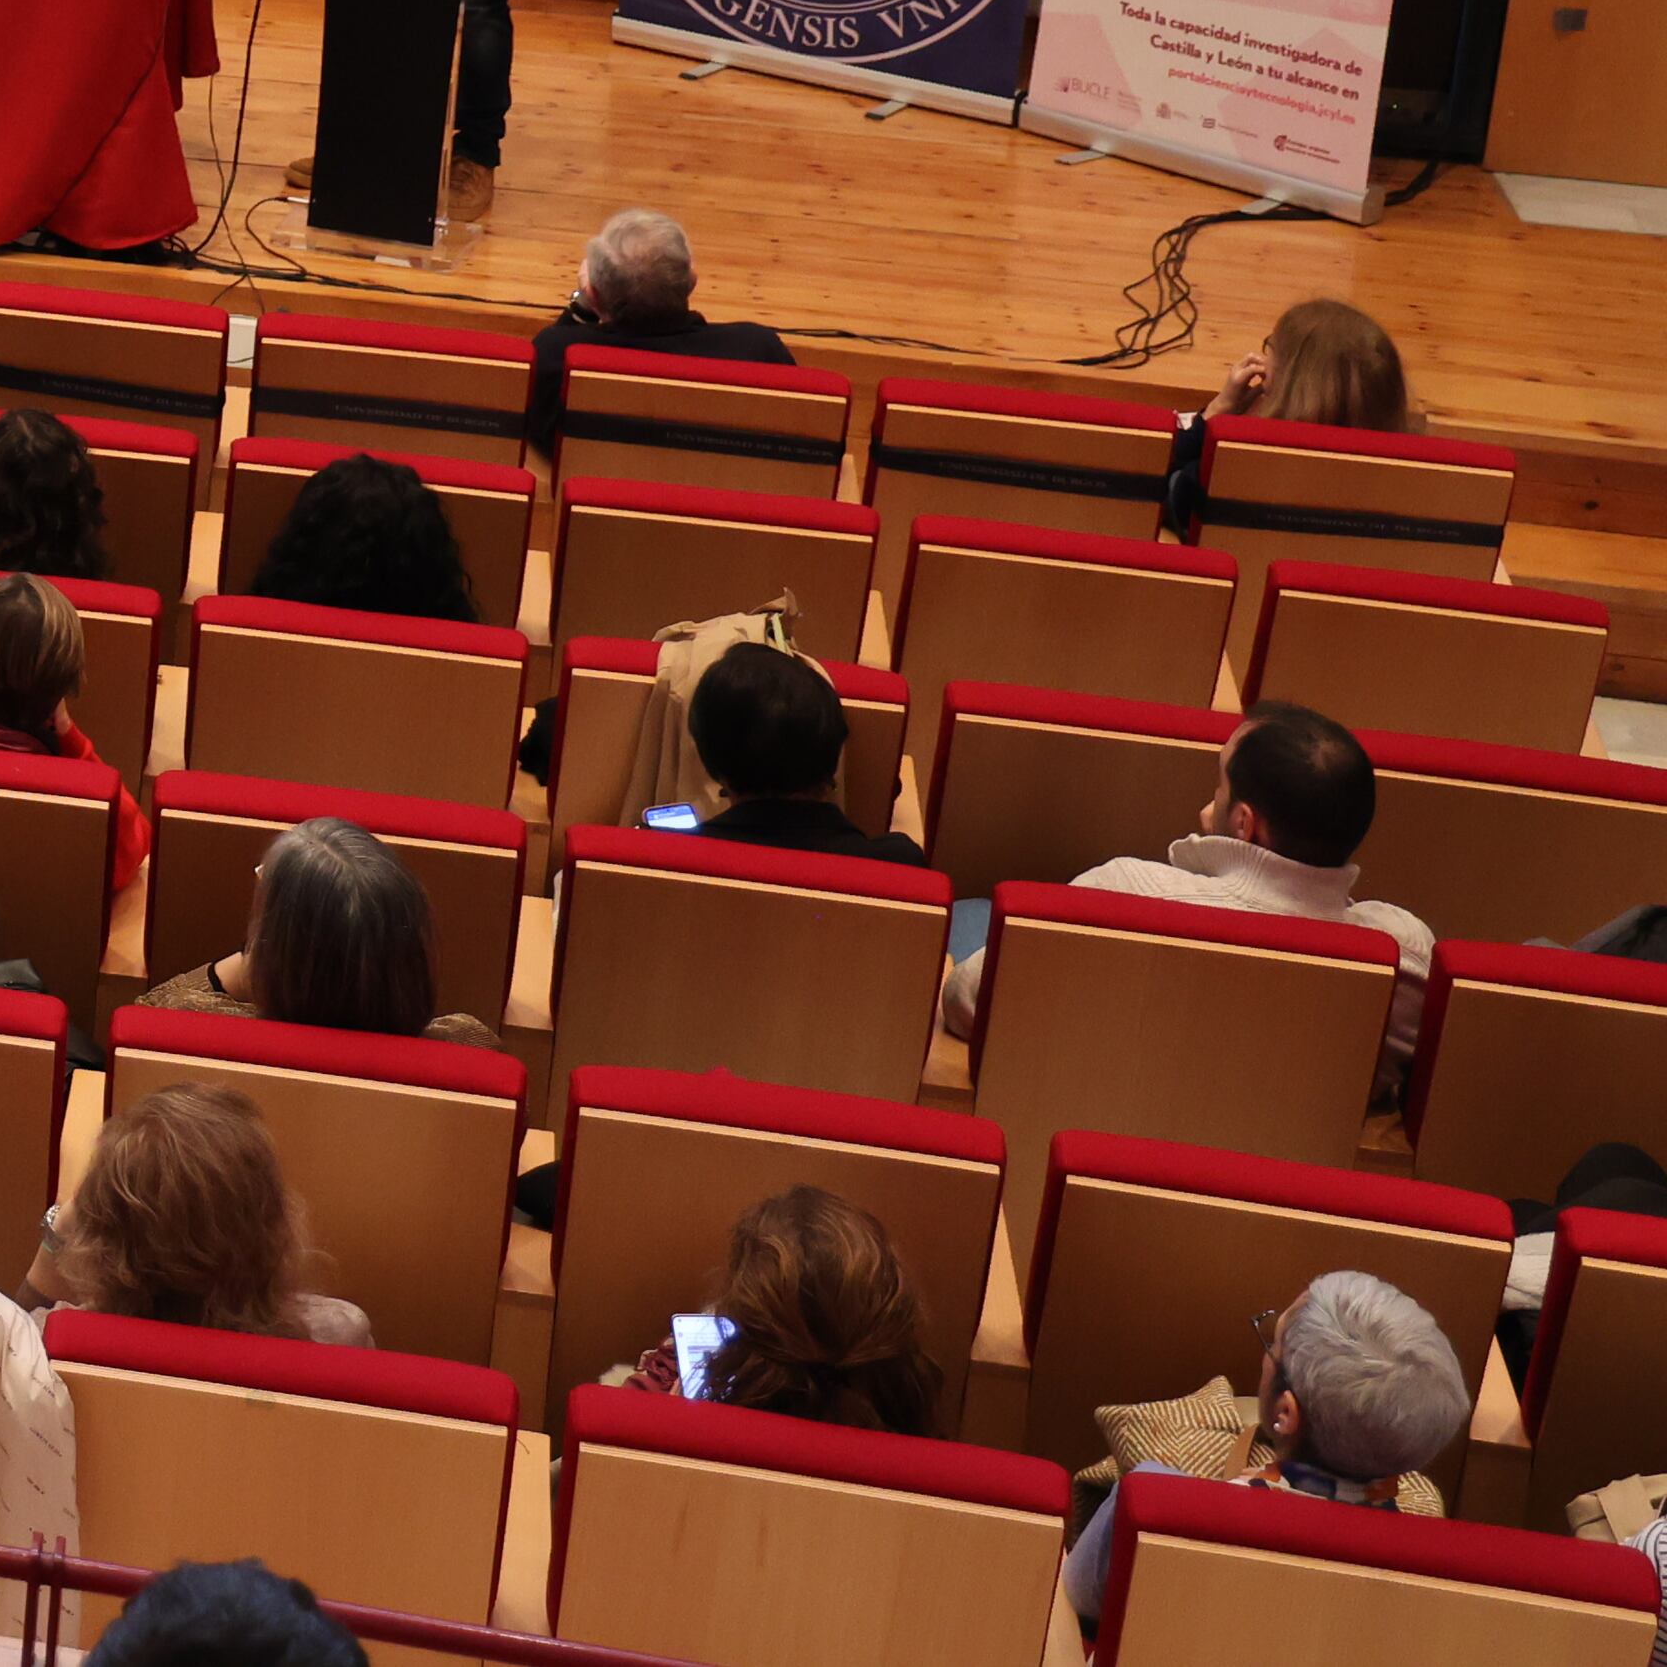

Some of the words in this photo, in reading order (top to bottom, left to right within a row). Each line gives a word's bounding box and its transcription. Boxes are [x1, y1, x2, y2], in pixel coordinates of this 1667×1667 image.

[1119, 1, 1152, 23] Toda
[1154, 10, 1167, 27] la
[1169, 18, 1242, 45] capacidad
[1243, 33, 1342, 72] investigadora
[1344, 59, 1363, 77] de
[1149, 34, 1202, 59] Castilla
[1205, 51, 1215, 64] y
[1217, 49, 1253, 73] León
[1255, 65, 1264, 75] a
[1266, 64, 1284, 80] tu
[1285, 70, 1338, 96] alcance
[1342, 86, 1360, 102] en
[1070, 77, 1112, 100] BUCLE
